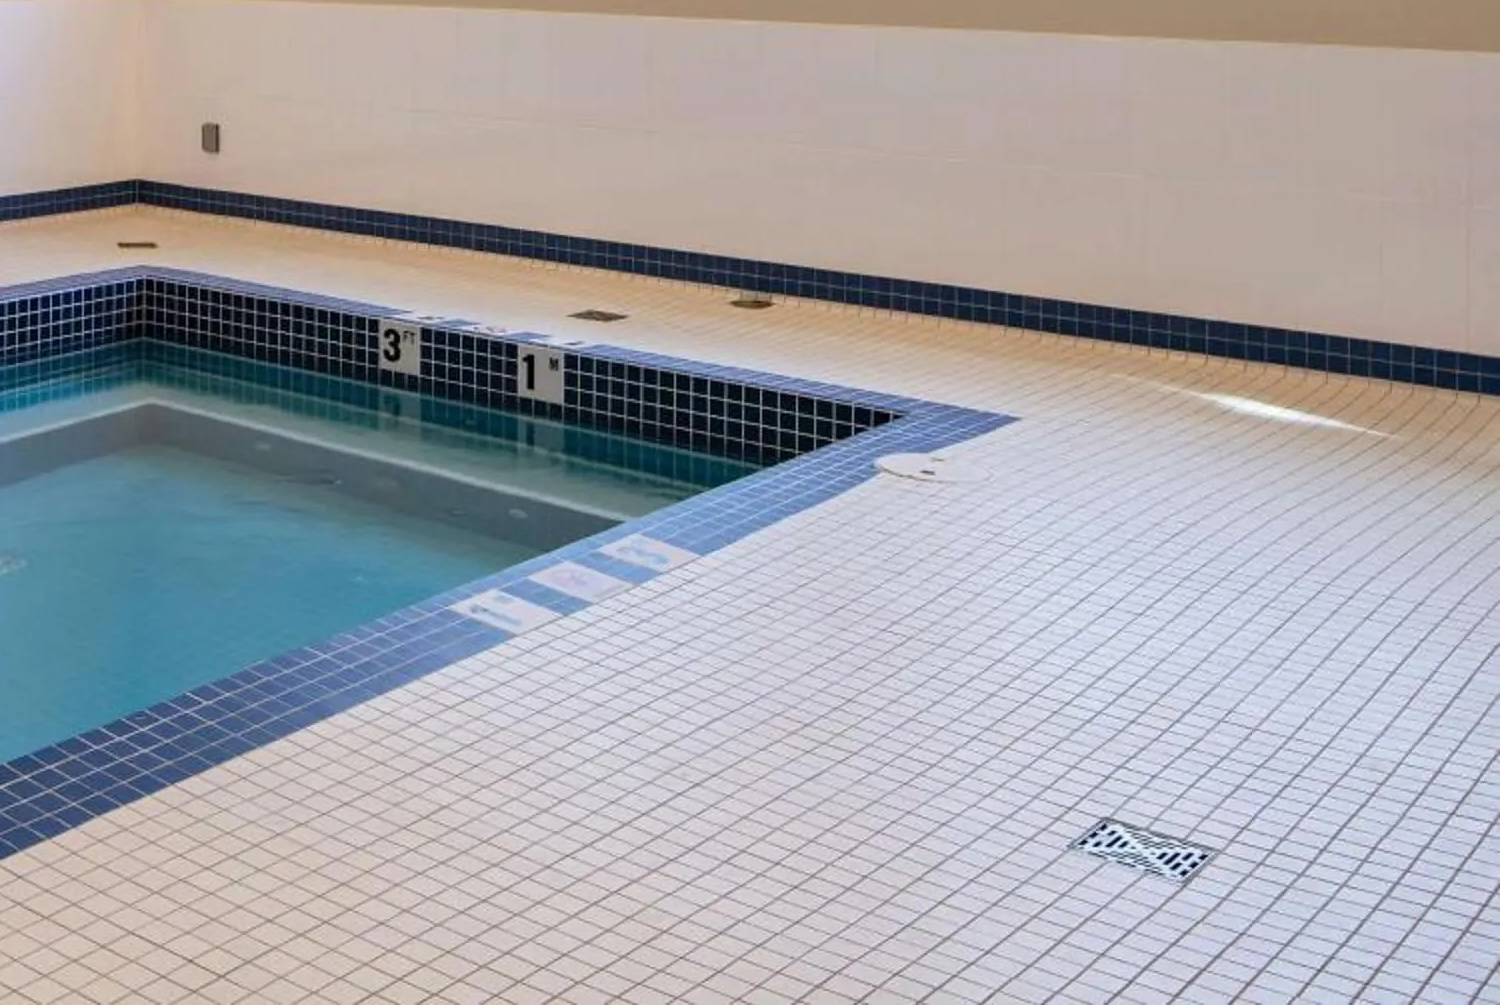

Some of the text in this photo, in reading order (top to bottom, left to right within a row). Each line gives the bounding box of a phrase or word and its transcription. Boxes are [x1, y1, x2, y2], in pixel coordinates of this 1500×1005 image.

[383, 328, 416, 362] 3 FT
[522, 353, 535, 391] 1
